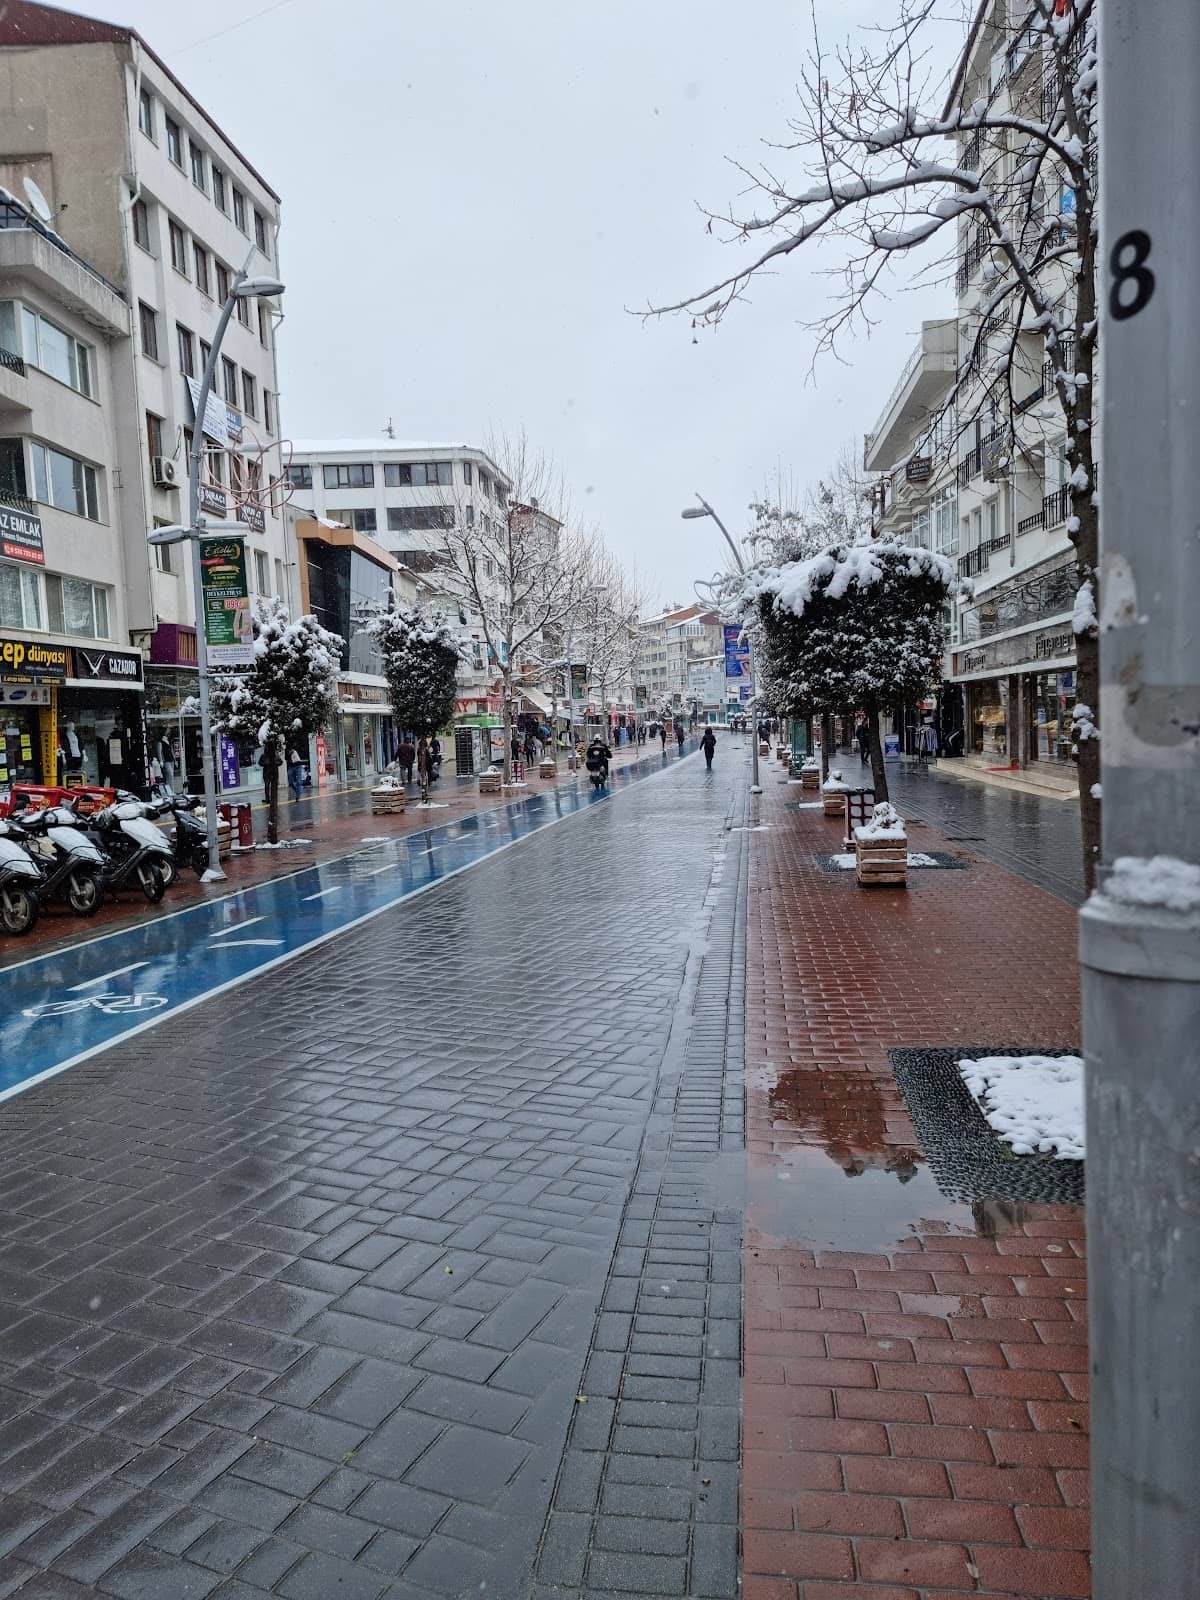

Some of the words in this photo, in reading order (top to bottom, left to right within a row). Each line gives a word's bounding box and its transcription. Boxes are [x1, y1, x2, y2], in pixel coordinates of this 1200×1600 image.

[1109, 229, 1155, 321] 8
[10, 516, 41, 538] EMLAK
[28, 645, 65, 667] dünyası
[108, 658, 137, 676] CAZADOR
